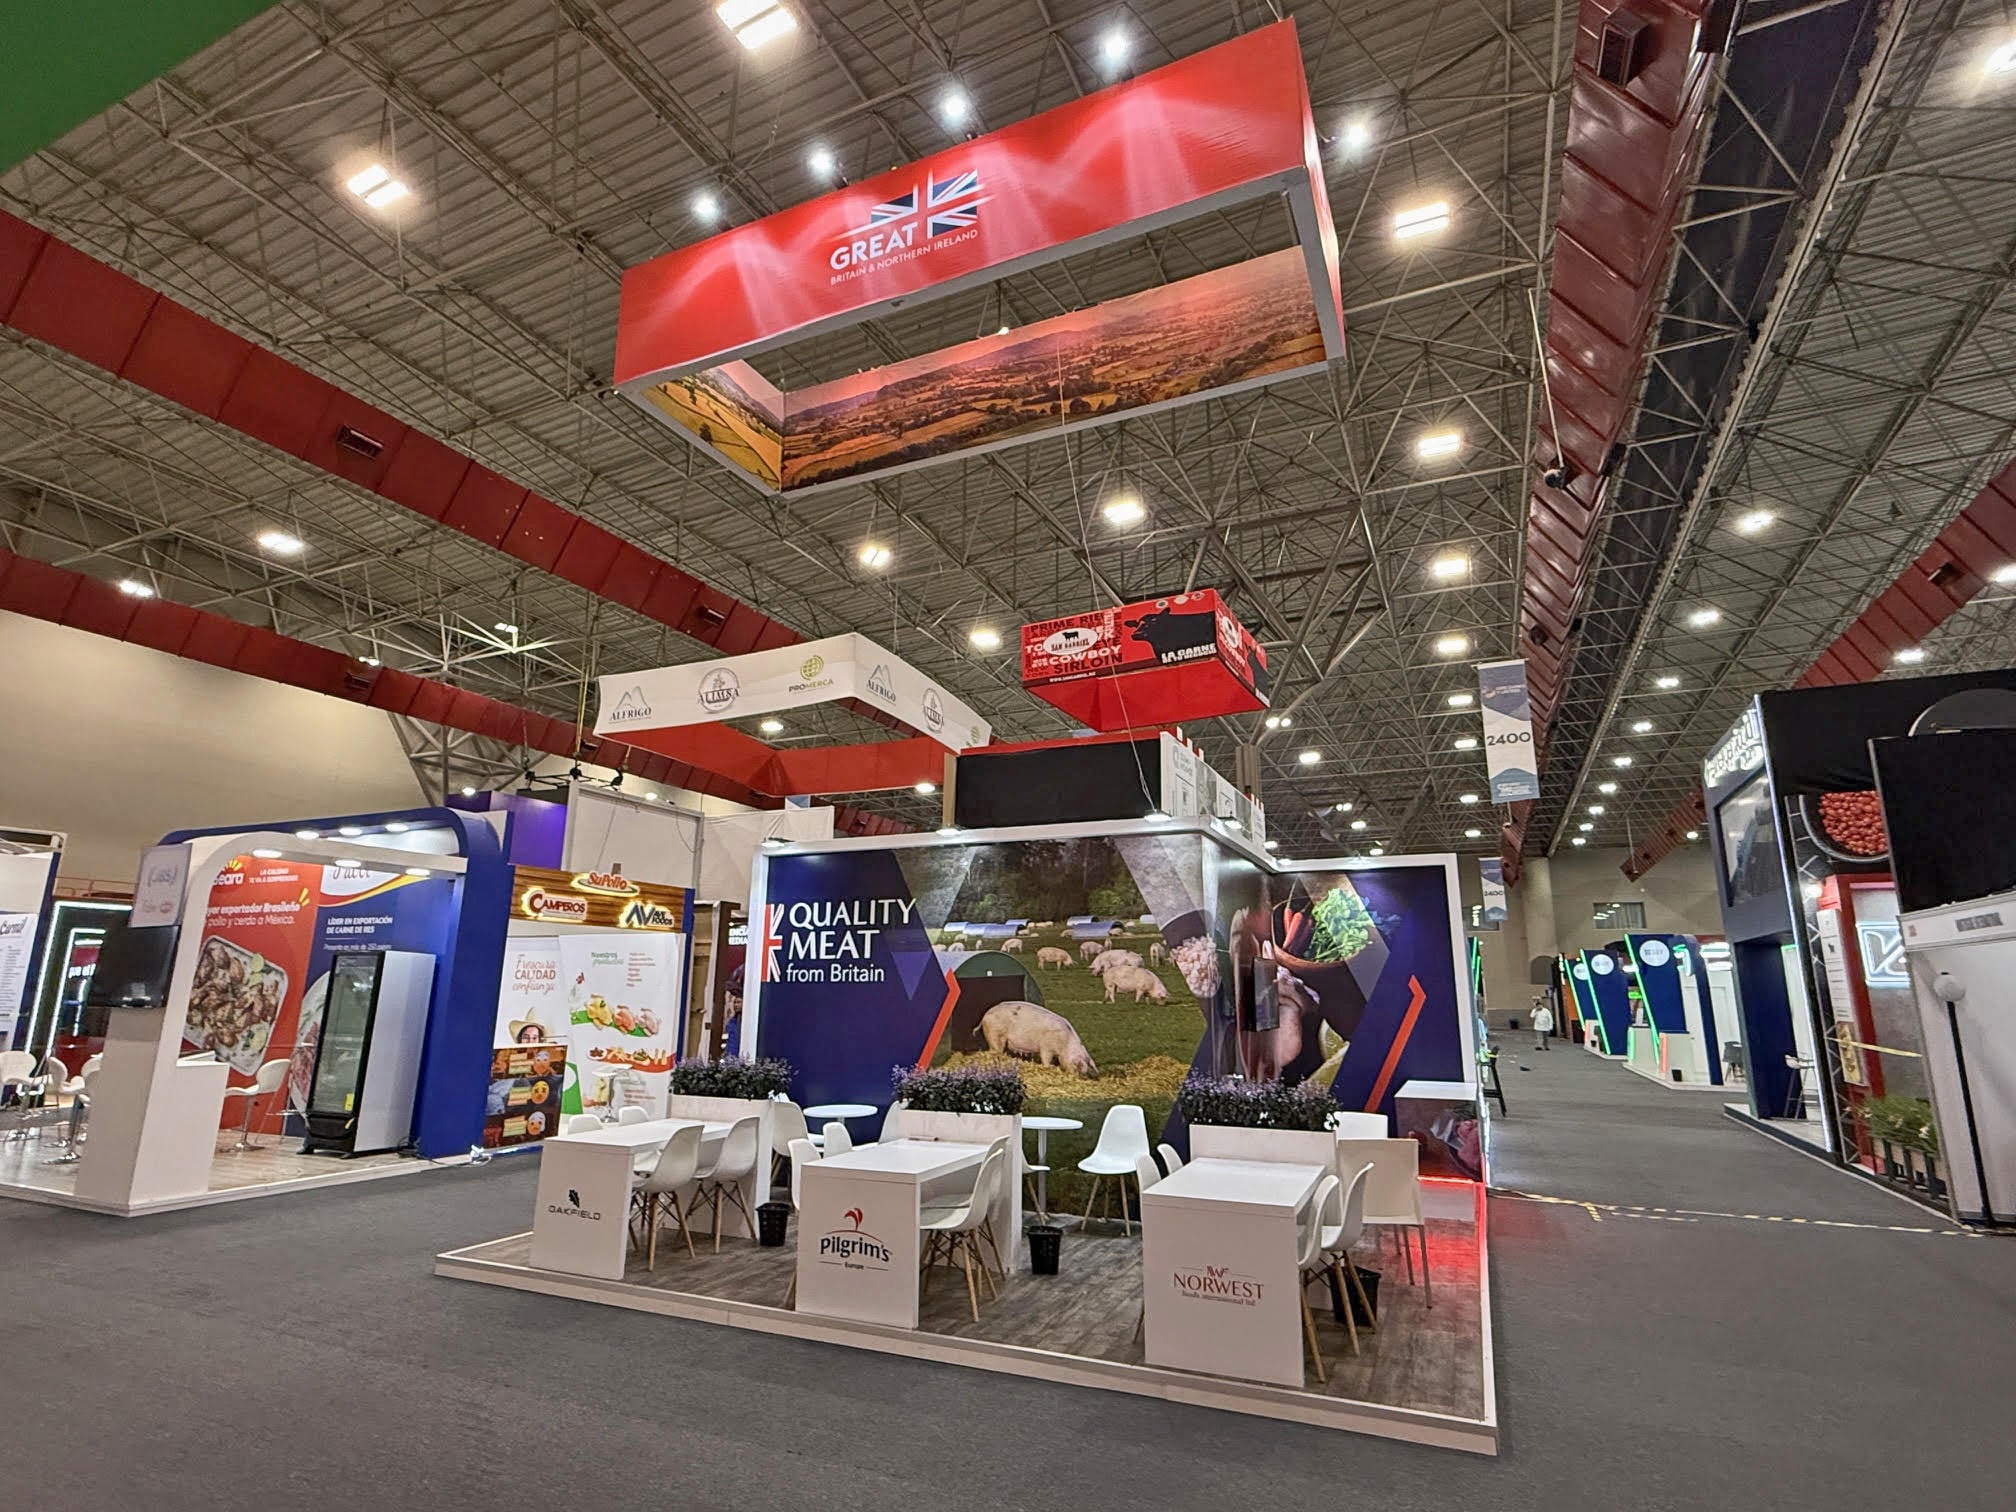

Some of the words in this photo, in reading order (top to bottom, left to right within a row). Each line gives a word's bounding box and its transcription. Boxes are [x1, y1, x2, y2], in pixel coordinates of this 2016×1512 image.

[829, 221, 918, 271] GREAT
[830, 262, 867, 286] BRITAIN
[868, 261, 876, 273] &
[876, 244, 931, 269] NORTHERN
[933, 229, 979, 251] IRELAND
[1030, 618, 1075, 632] PRIME
[1049, 644, 1121, 666] COWBOY
[1053, 653, 1123, 674] SIRLOIN
[788, 678, 834, 693] PROMERCA
[866, 679, 897, 703] ALFRIGO
[608, 706, 652, 722] ALFRIGO
[1486, 731, 1531, 746] 2400
[220, 903, 263, 916] exportador
[263, 901, 300, 912] Brasileño
[529, 893, 586, 913] CAMPEROS
[789, 898, 916, 930] QUALITY
[335, 926, 354, 934] CARNE
[788, 929, 880, 961] MEAT
[514, 969, 556, 980] CALIDAD
[786, 963, 825, 983] from
[830, 963, 885, 983] Britain
[548, 1205, 601, 1221] OAKFIELD
[820, 1236, 890, 1262] Pilgrim's
[1173, 1272, 1265, 1300] NORWEST
